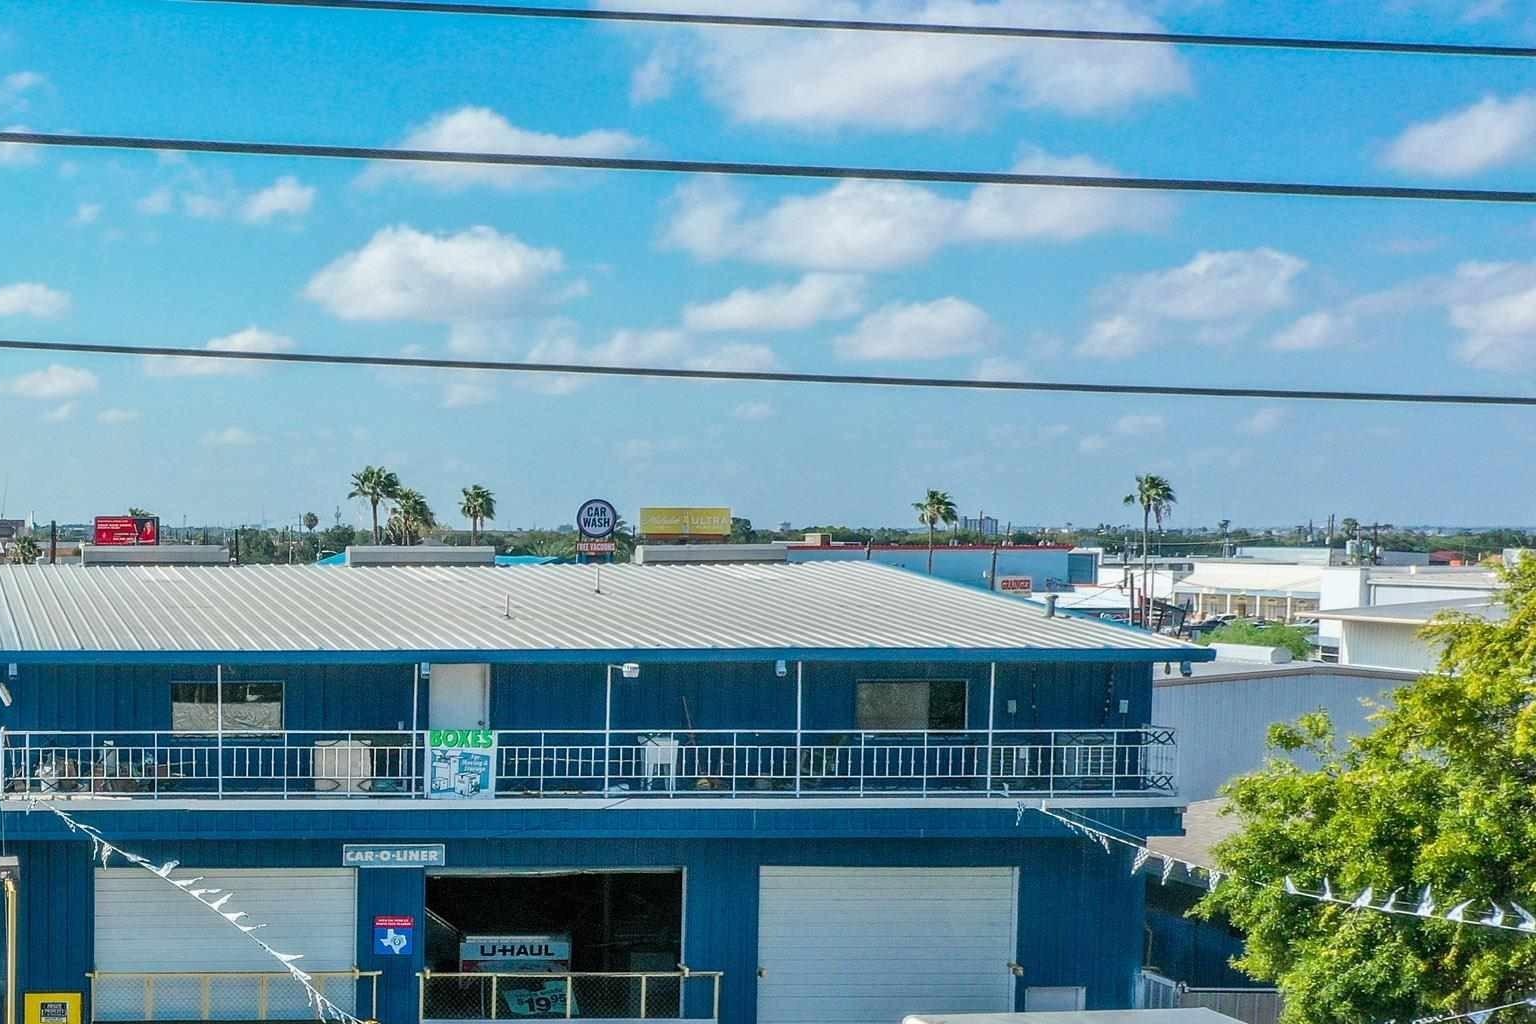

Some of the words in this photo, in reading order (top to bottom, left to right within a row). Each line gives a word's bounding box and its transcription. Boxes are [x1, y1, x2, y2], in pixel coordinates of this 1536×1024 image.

[587, 507, 607, 517] CAR
[583, 518, 610, 528] WASH
[430, 730, 493, 748] BOXES
[480, 944, 555, 957] U-HAUL
